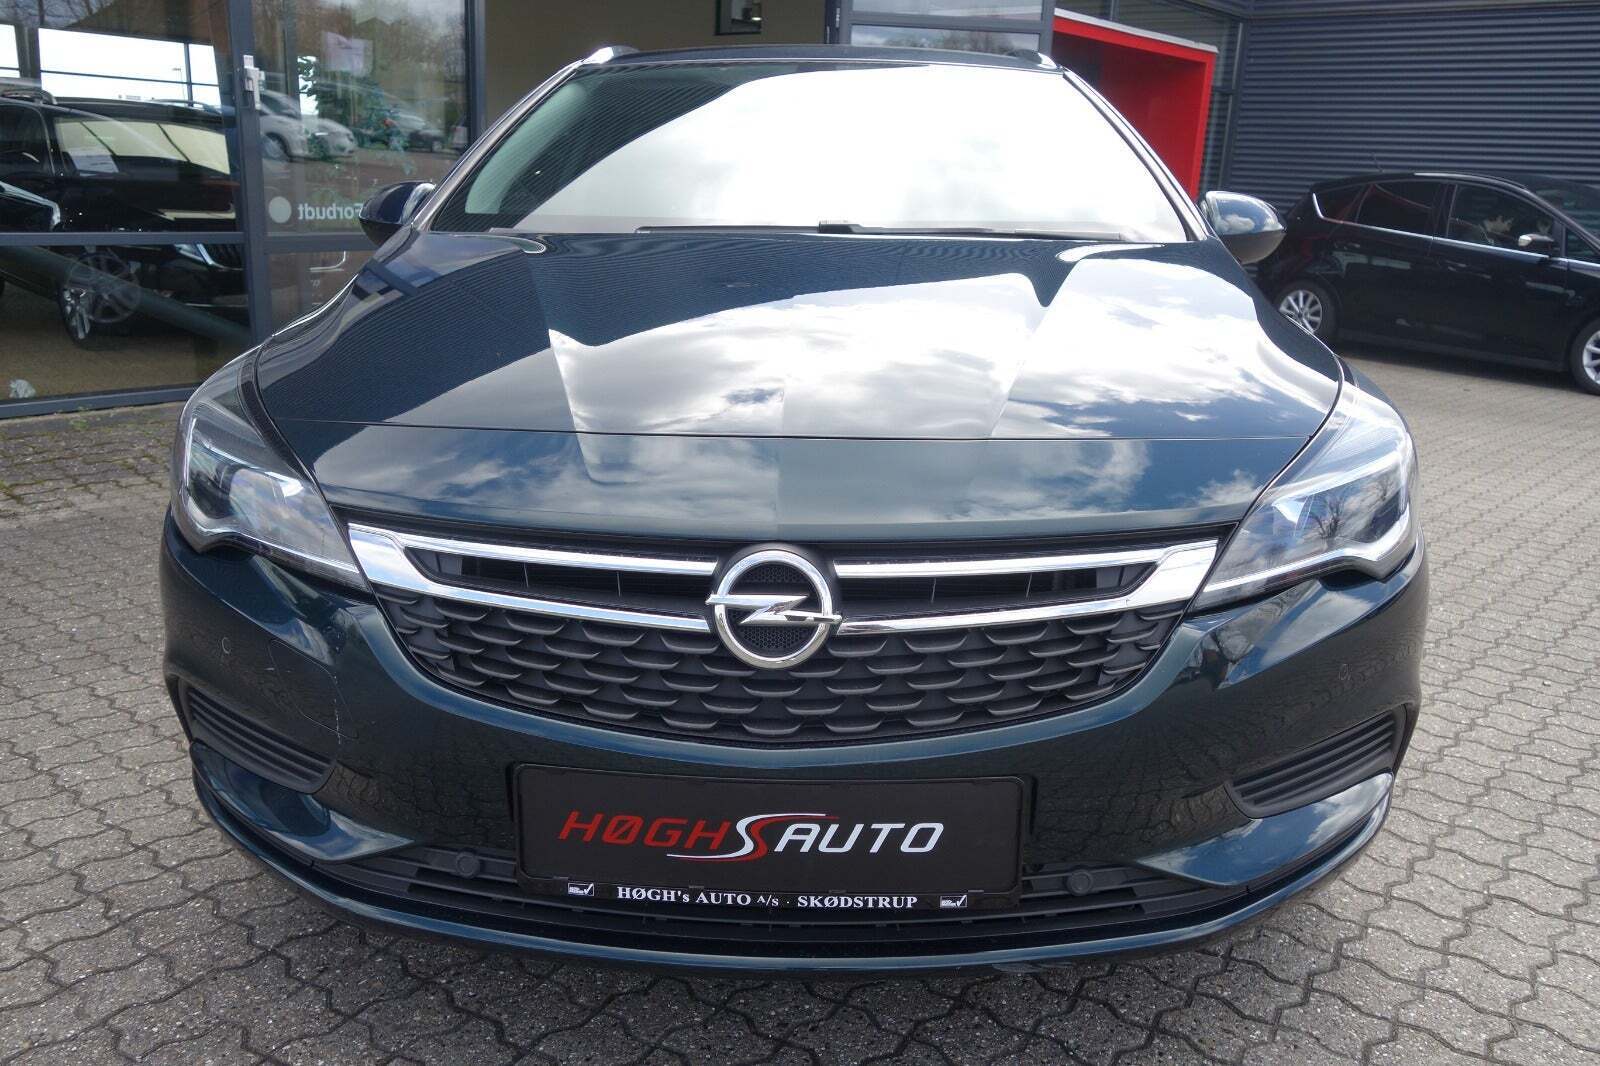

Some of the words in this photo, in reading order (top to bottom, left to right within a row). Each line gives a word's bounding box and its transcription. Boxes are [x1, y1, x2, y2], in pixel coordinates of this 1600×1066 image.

[773, 823, 945, 853] AUTO
[617, 886, 690, 903] HØGH's
[696, 892, 751, 906] AUTO
[797, 896, 918, 908] SKØDSTRUP
